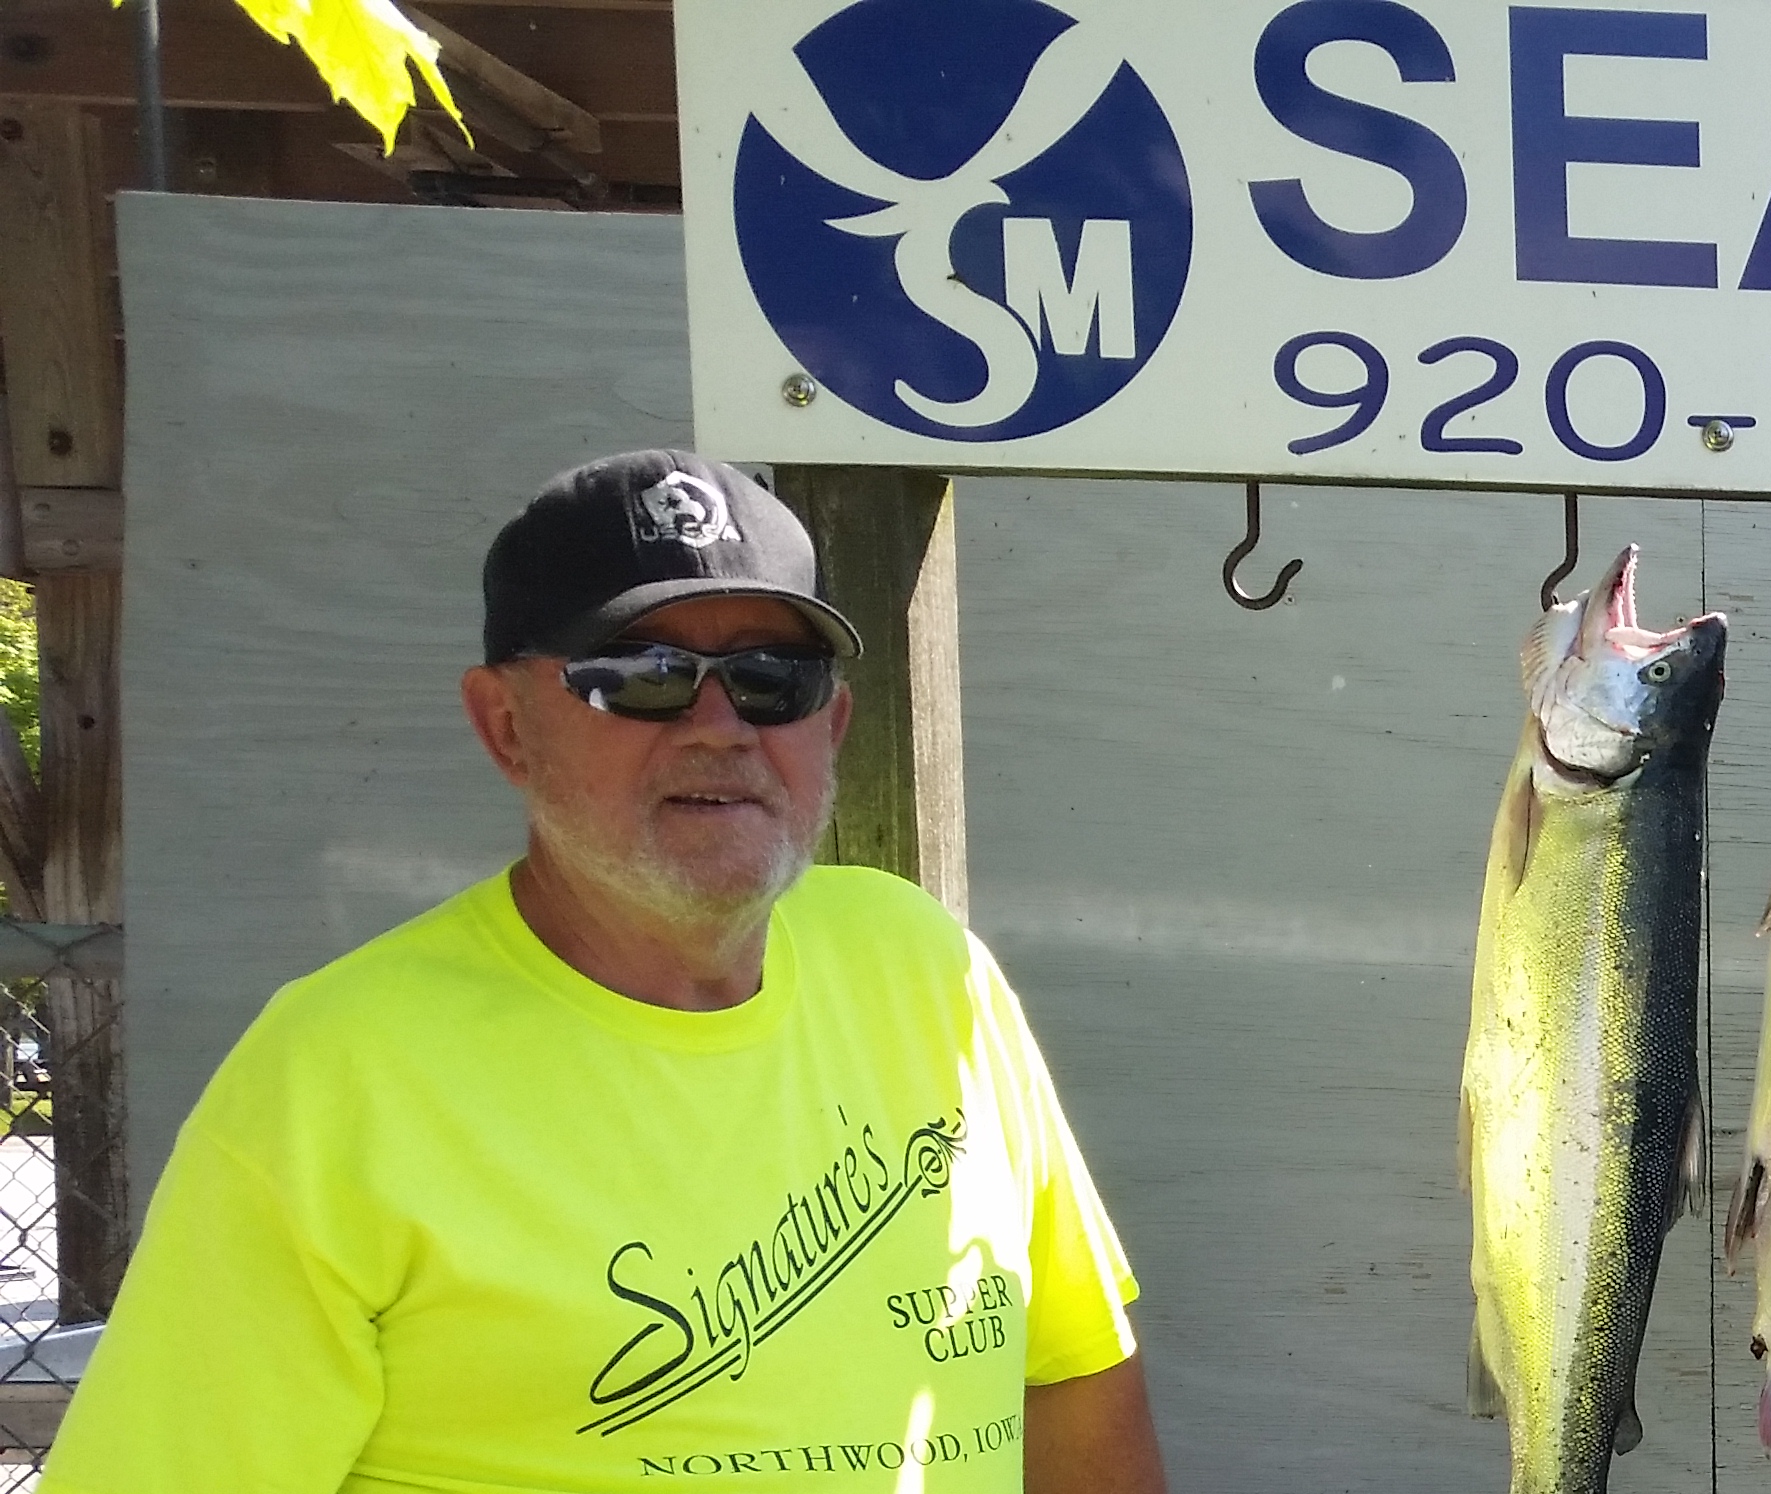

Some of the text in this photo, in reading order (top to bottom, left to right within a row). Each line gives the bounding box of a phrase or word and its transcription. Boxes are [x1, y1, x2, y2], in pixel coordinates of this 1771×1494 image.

[590, 1104, 890, 1405] Signature's
[886, 1274, 1013, 1329] SUPPER
[924, 1315, 1006, 1363] CLUB
[636, 1432, 969, 1477] NORTHWOOD,
